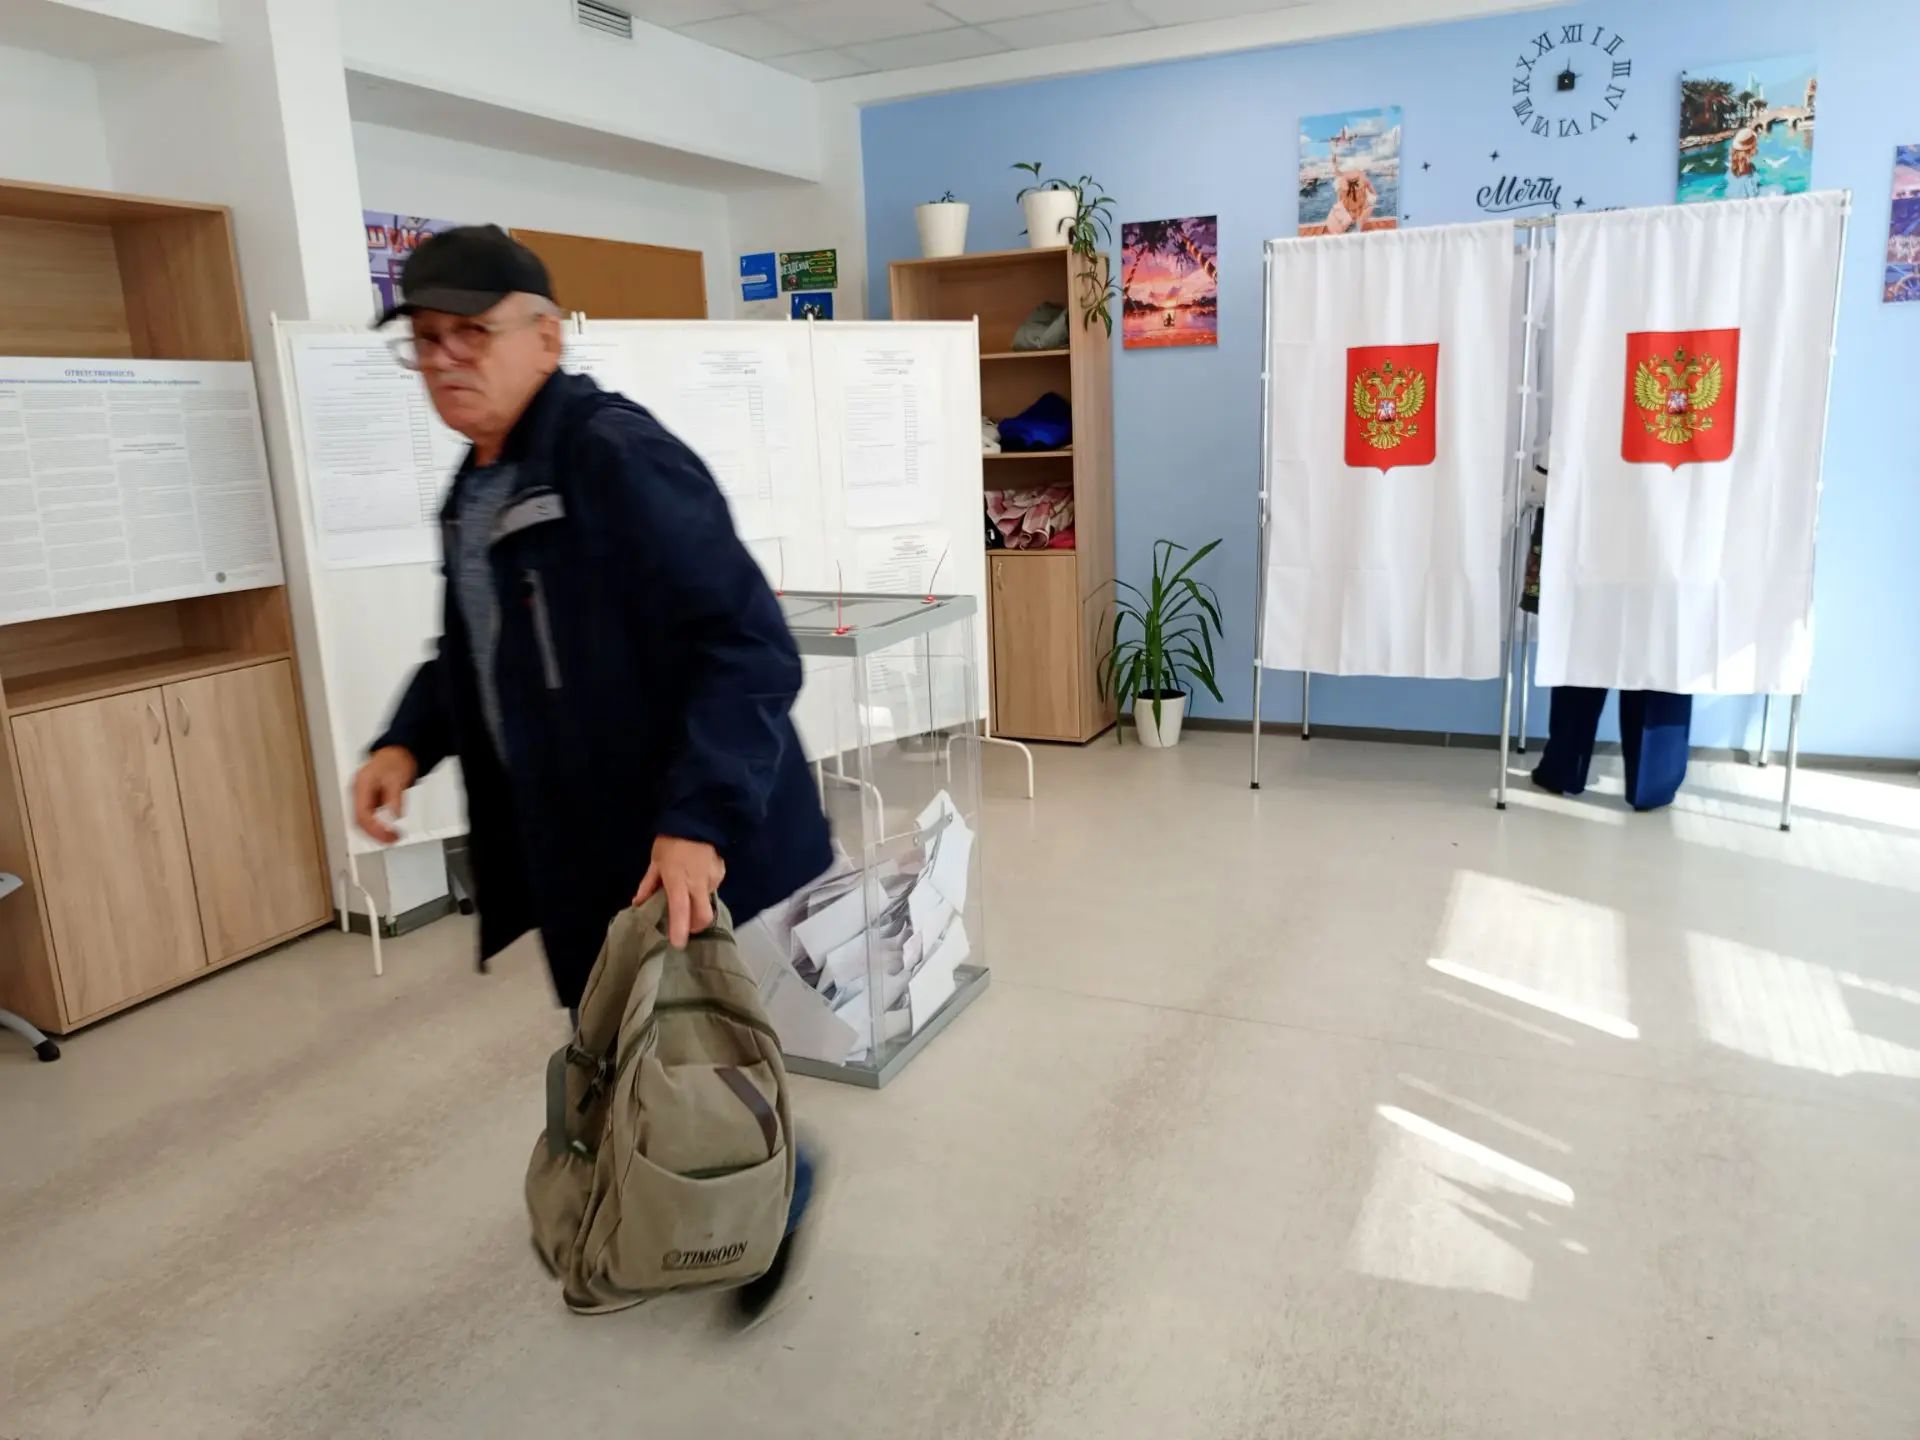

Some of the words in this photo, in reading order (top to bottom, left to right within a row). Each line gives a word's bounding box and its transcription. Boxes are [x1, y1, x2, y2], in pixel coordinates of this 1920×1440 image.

[1531, 31, 1555, 57] XI
[1560, 24, 1584, 44] XII
[1590, 26, 1605, 46] I
[1603, 33, 1624, 56] II
[1516, 54, 1536, 72] X
[1611, 58, 1631, 79] III
[1512, 75, 1530, 96] IX
[1604, 84, 1626, 111] IV
[1512, 97, 1534, 125] VIII
[1590, 111, 1608, 131] V
[1530, 115, 1550, 138] VII
[1558, 119, 1583, 138] VI
